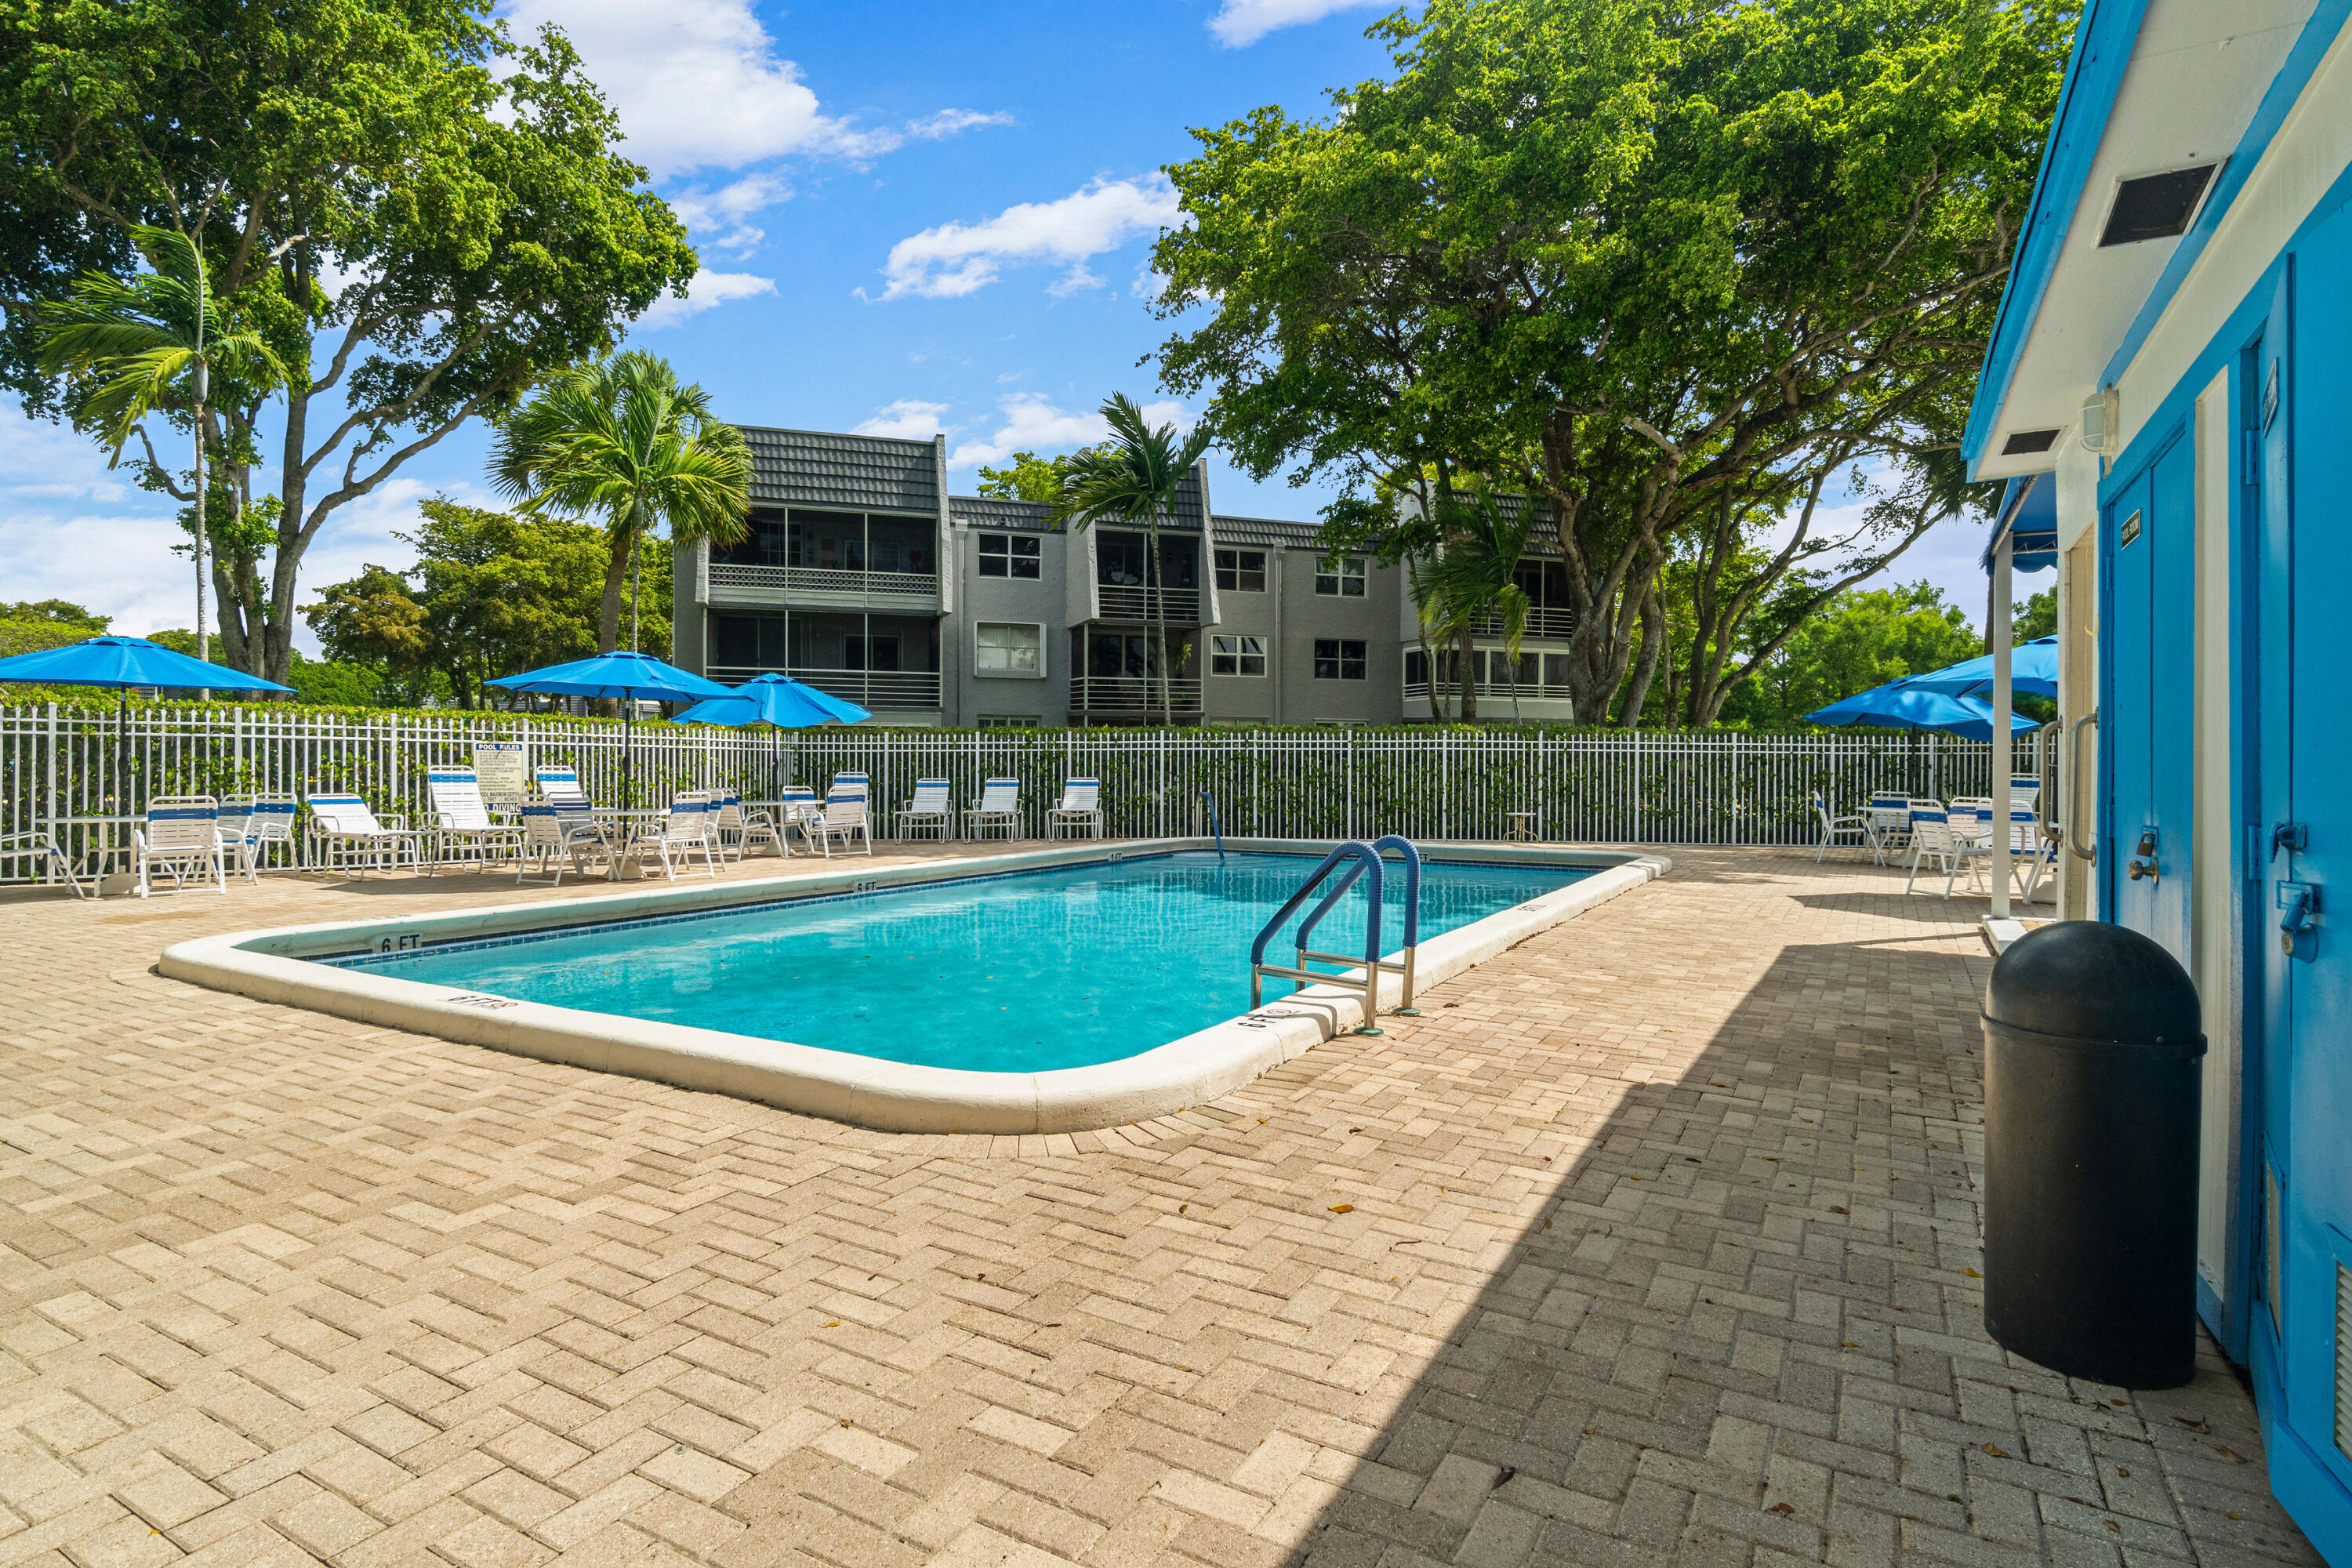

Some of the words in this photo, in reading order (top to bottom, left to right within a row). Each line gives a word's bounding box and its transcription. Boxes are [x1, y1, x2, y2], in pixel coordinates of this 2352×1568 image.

[492, 803, 521, 813] DIVING
[866, 881, 877, 891] FT
[382, 938, 391, 953] 6
[399, 934, 420, 950] FT
